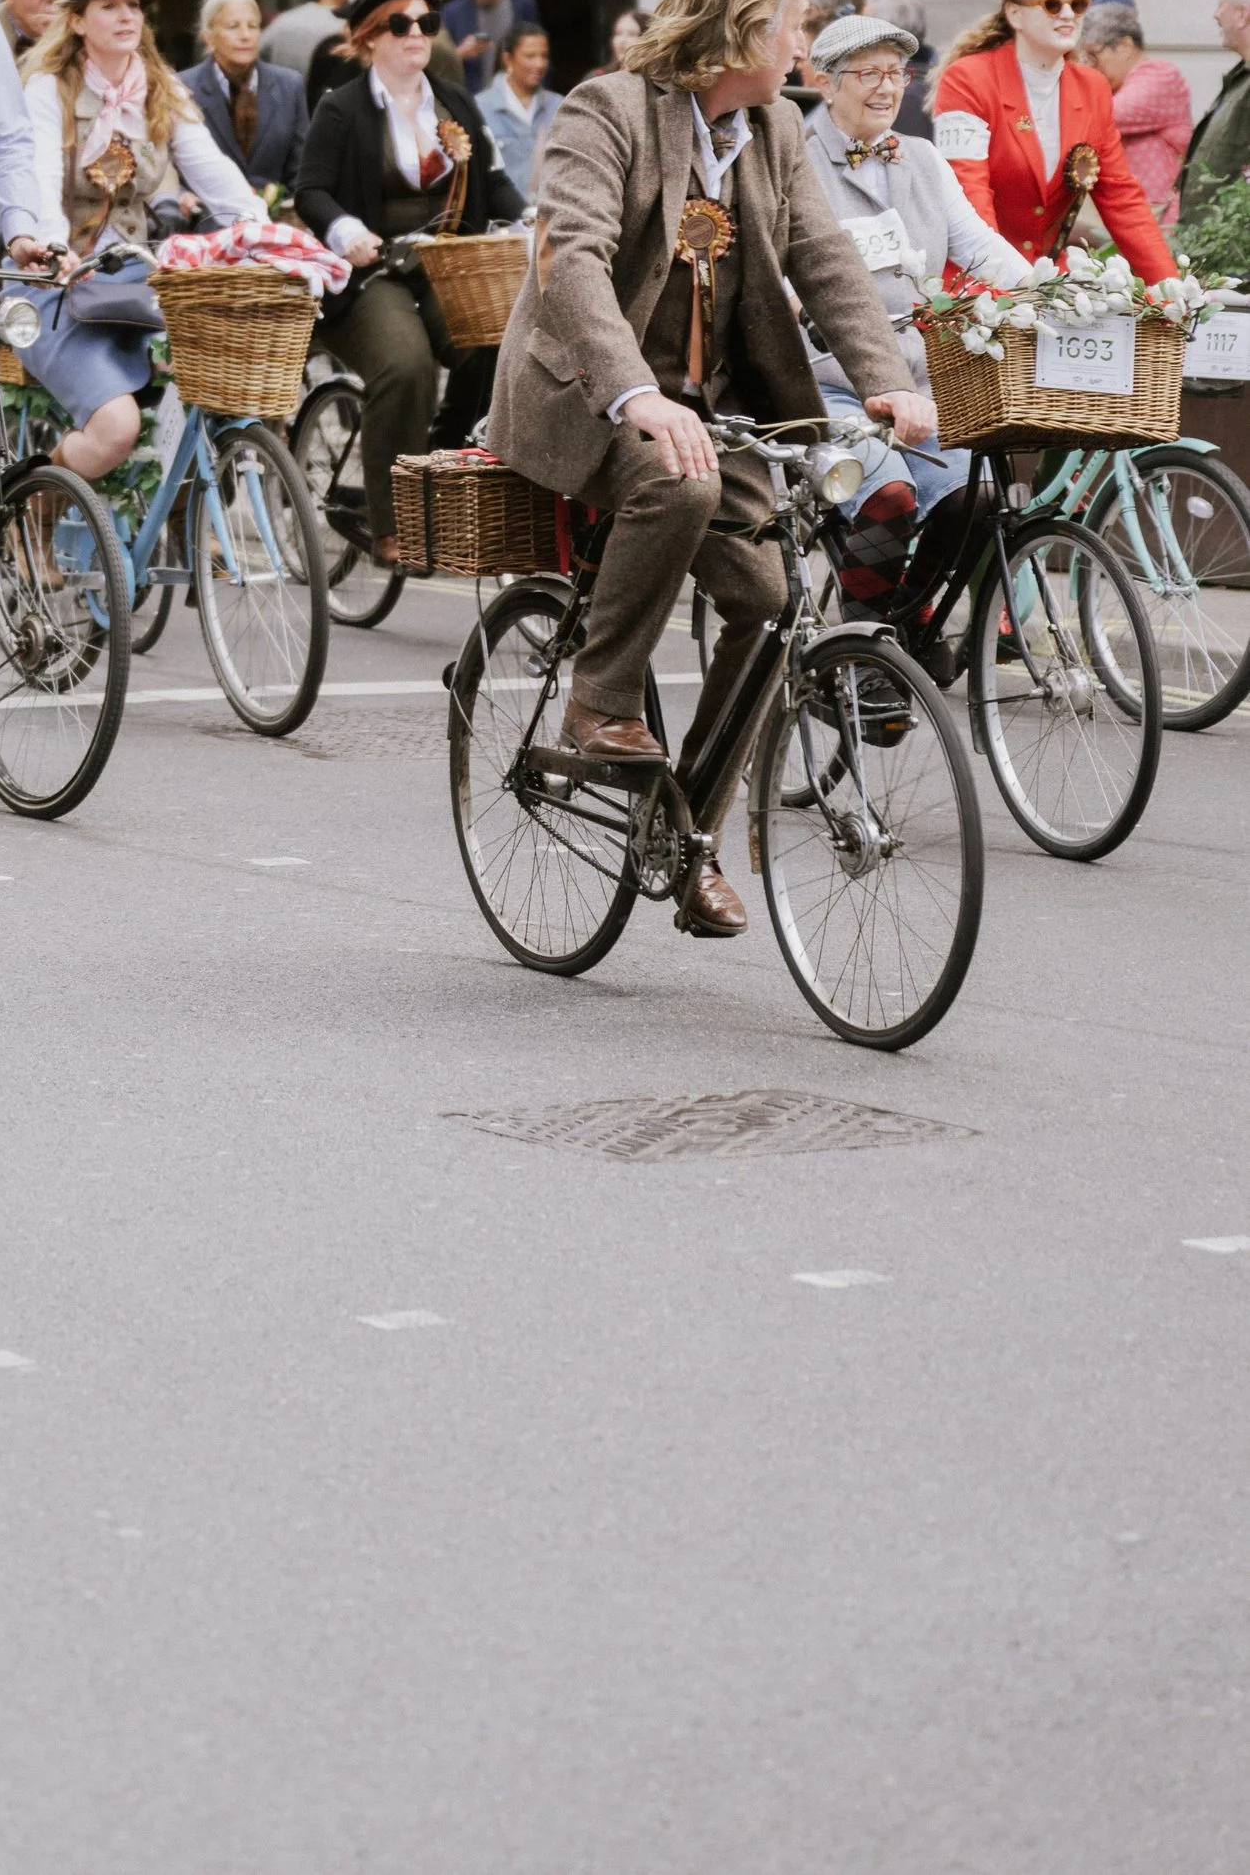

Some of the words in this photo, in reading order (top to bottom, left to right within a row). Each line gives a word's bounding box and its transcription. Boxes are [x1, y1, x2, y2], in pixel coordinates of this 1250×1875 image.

[939, 127, 977, 147] 1117
[1055, 335, 1114, 362] 1693
[1206, 332, 1238, 352] 1117
